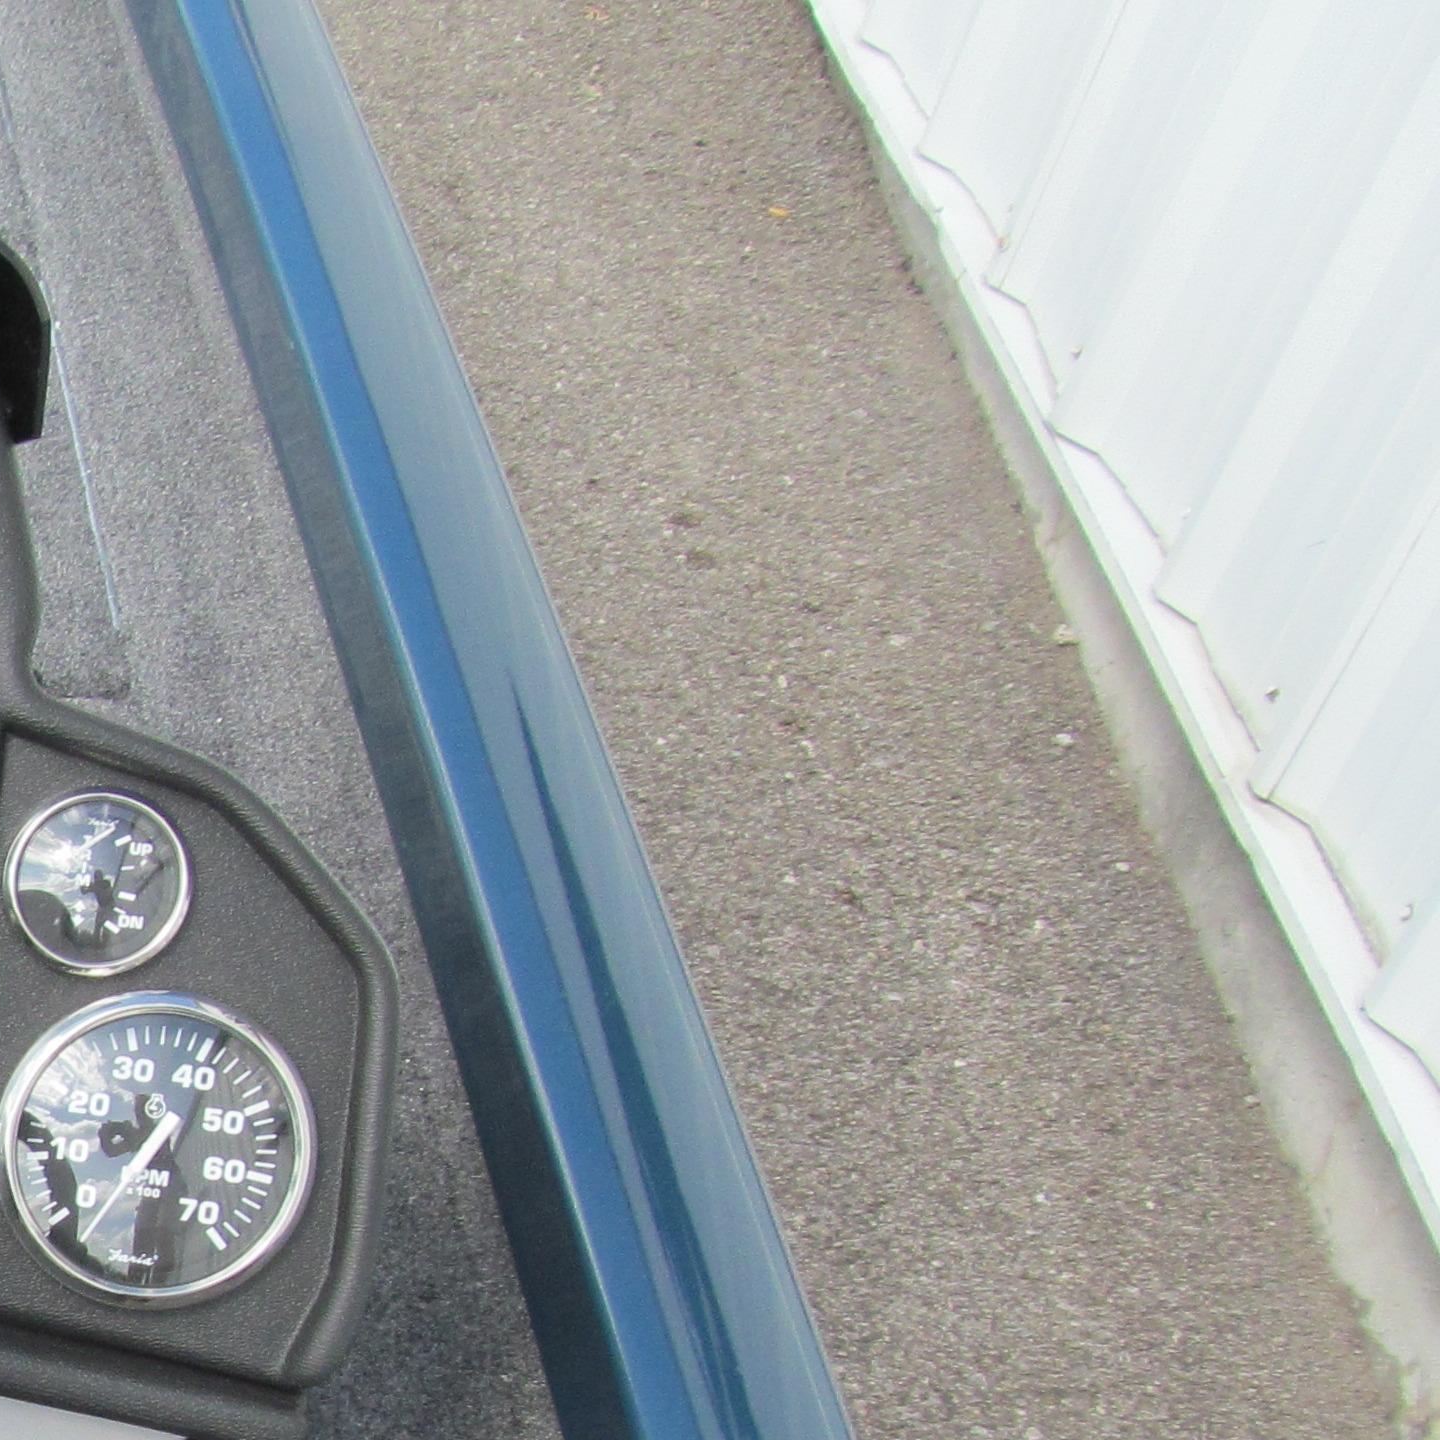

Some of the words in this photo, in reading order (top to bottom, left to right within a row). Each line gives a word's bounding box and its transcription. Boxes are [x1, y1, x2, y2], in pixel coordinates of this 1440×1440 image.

[129, 842, 154, 857] UP
[117, 915, 144, 930] DN
[112, 1055, 155, 1082] 30
[171, 1063, 215, 1091] 40
[67, 1090, 111, 1117] 20
[202, 1107, 244, 1134] 50
[50, 1136, 89, 1163] 10
[203, 1156, 246, 1184] 60
[75, 1184, 97, 1208] 0
[136, 1186, 161, 1199] 100
[178, 1197, 220, 1225] 70
